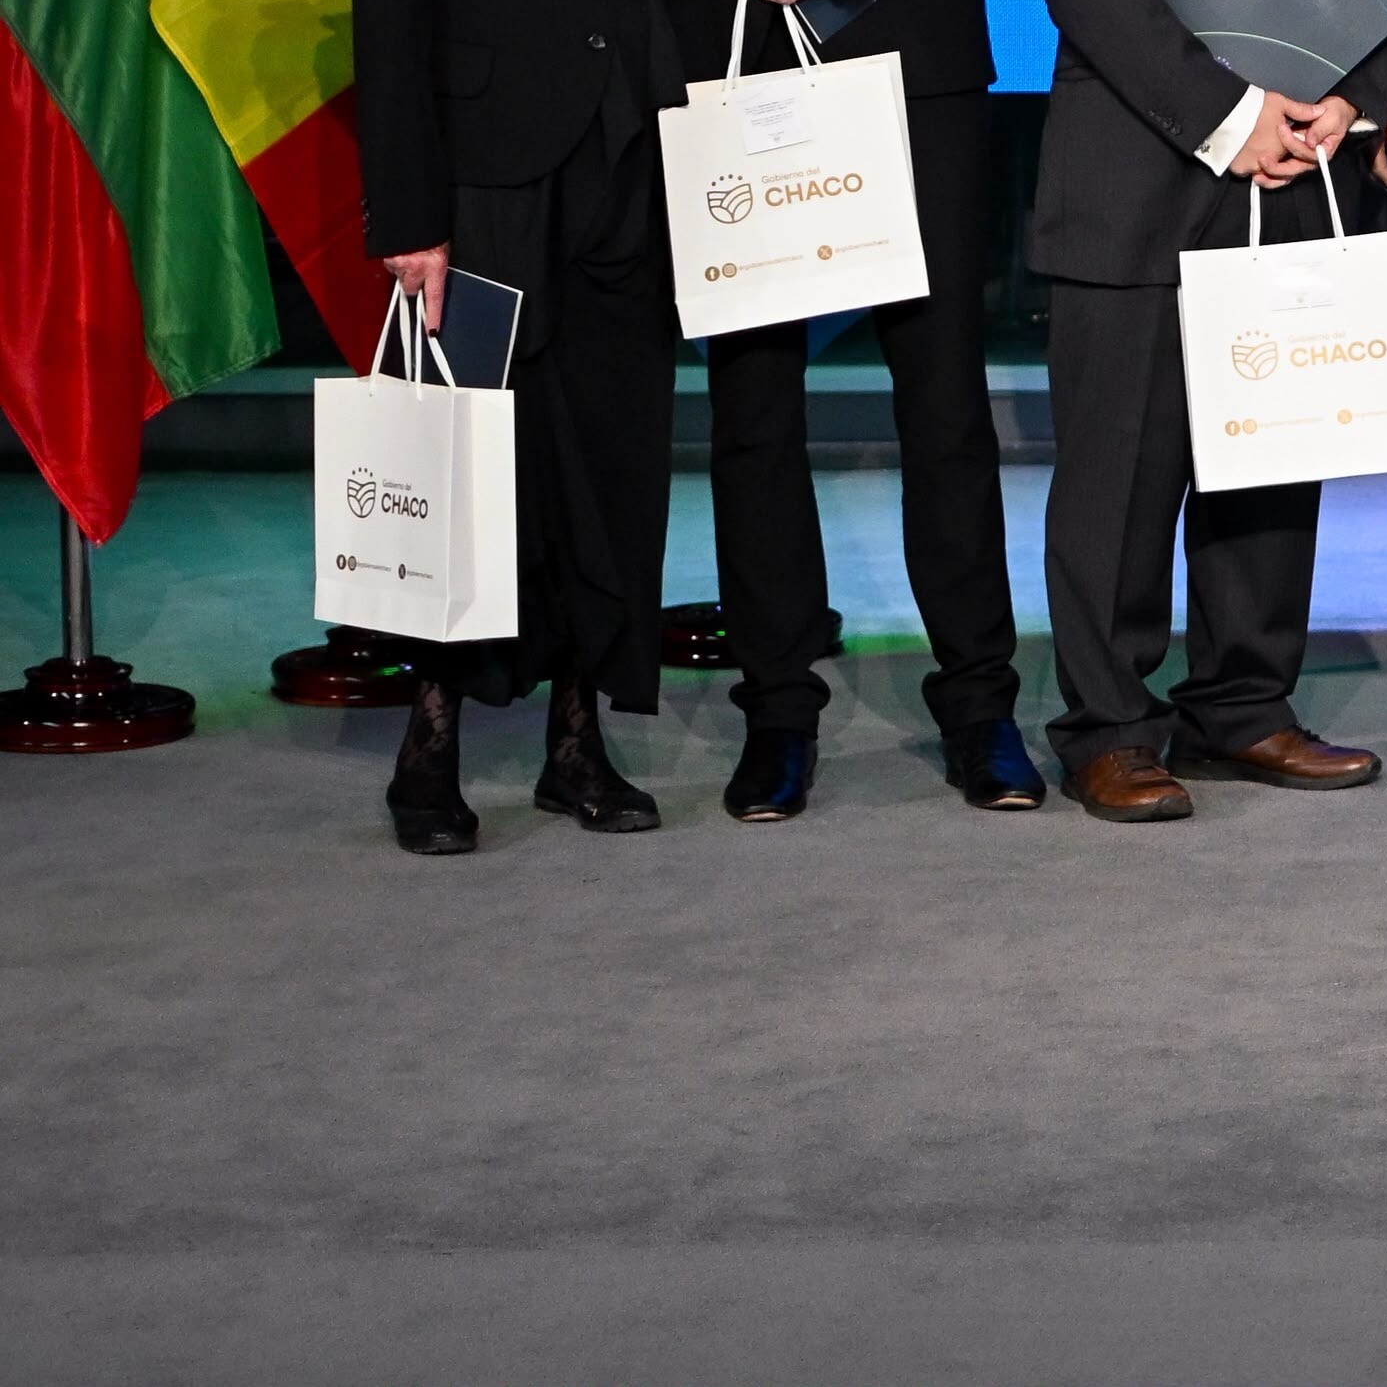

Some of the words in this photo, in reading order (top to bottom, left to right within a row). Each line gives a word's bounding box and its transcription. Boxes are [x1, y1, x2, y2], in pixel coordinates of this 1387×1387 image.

[765, 173, 863, 207] CHACO
[1289, 339, 1387, 368] CHACO
[381, 492, 429, 519] CHACO
